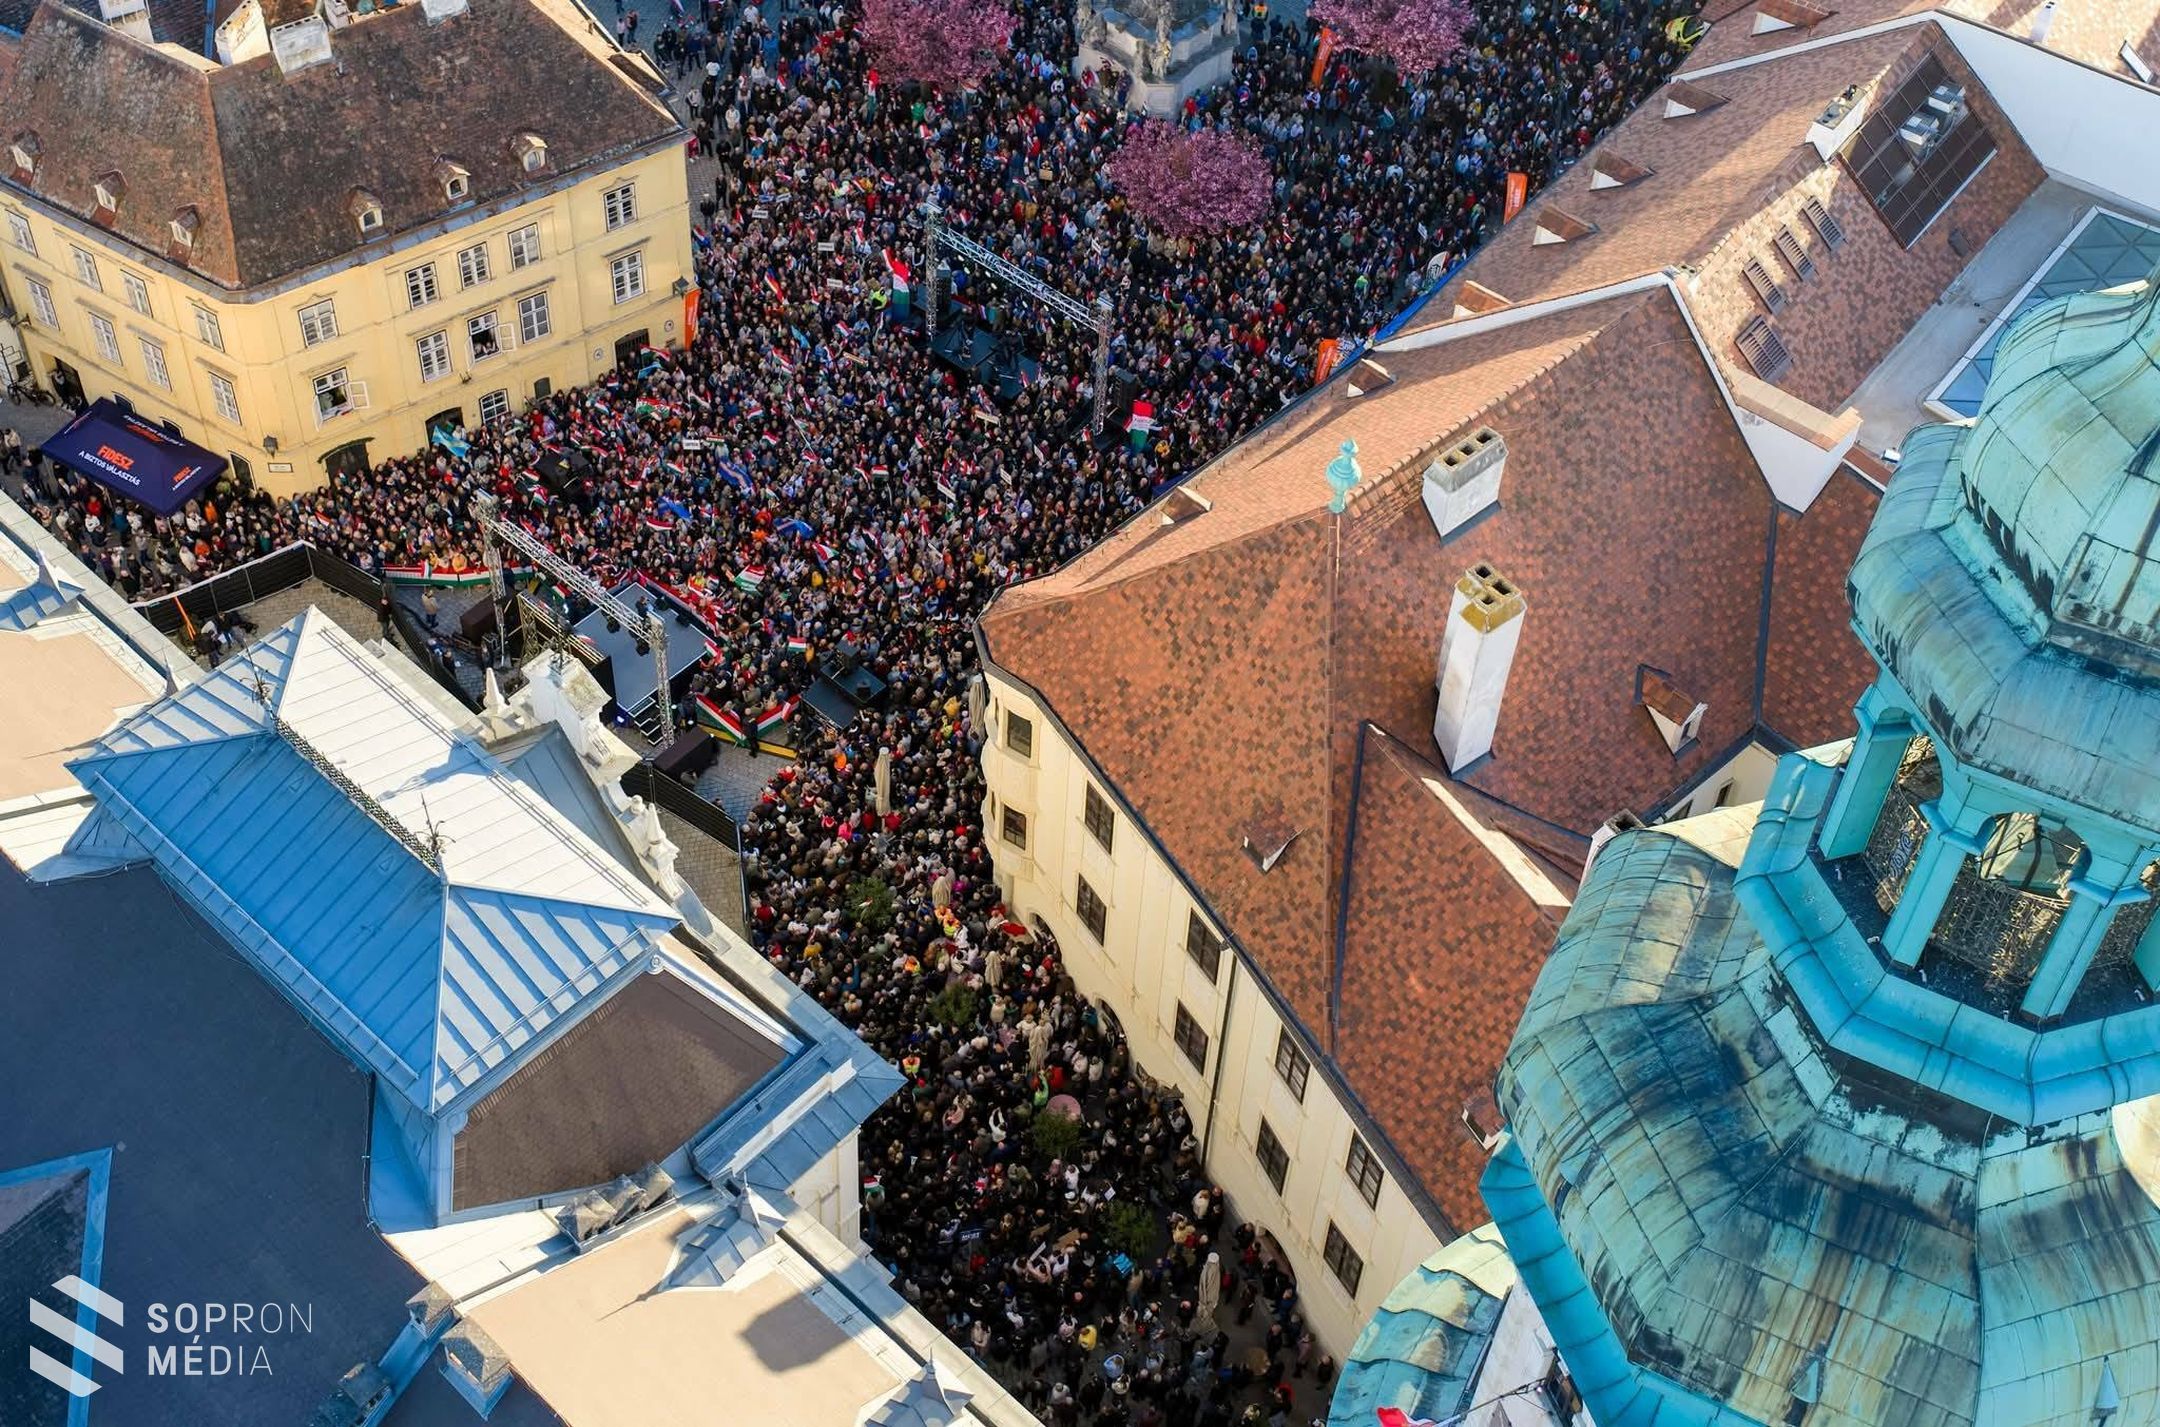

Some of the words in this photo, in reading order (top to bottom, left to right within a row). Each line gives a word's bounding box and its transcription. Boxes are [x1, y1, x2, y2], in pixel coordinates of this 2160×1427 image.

[78, 450, 85, 458] A
[84, 452, 107, 468] BIZTOS
[106, 463, 141, 486] VÁLASZTÁS
[97, 445, 135, 470] FIDESZ
